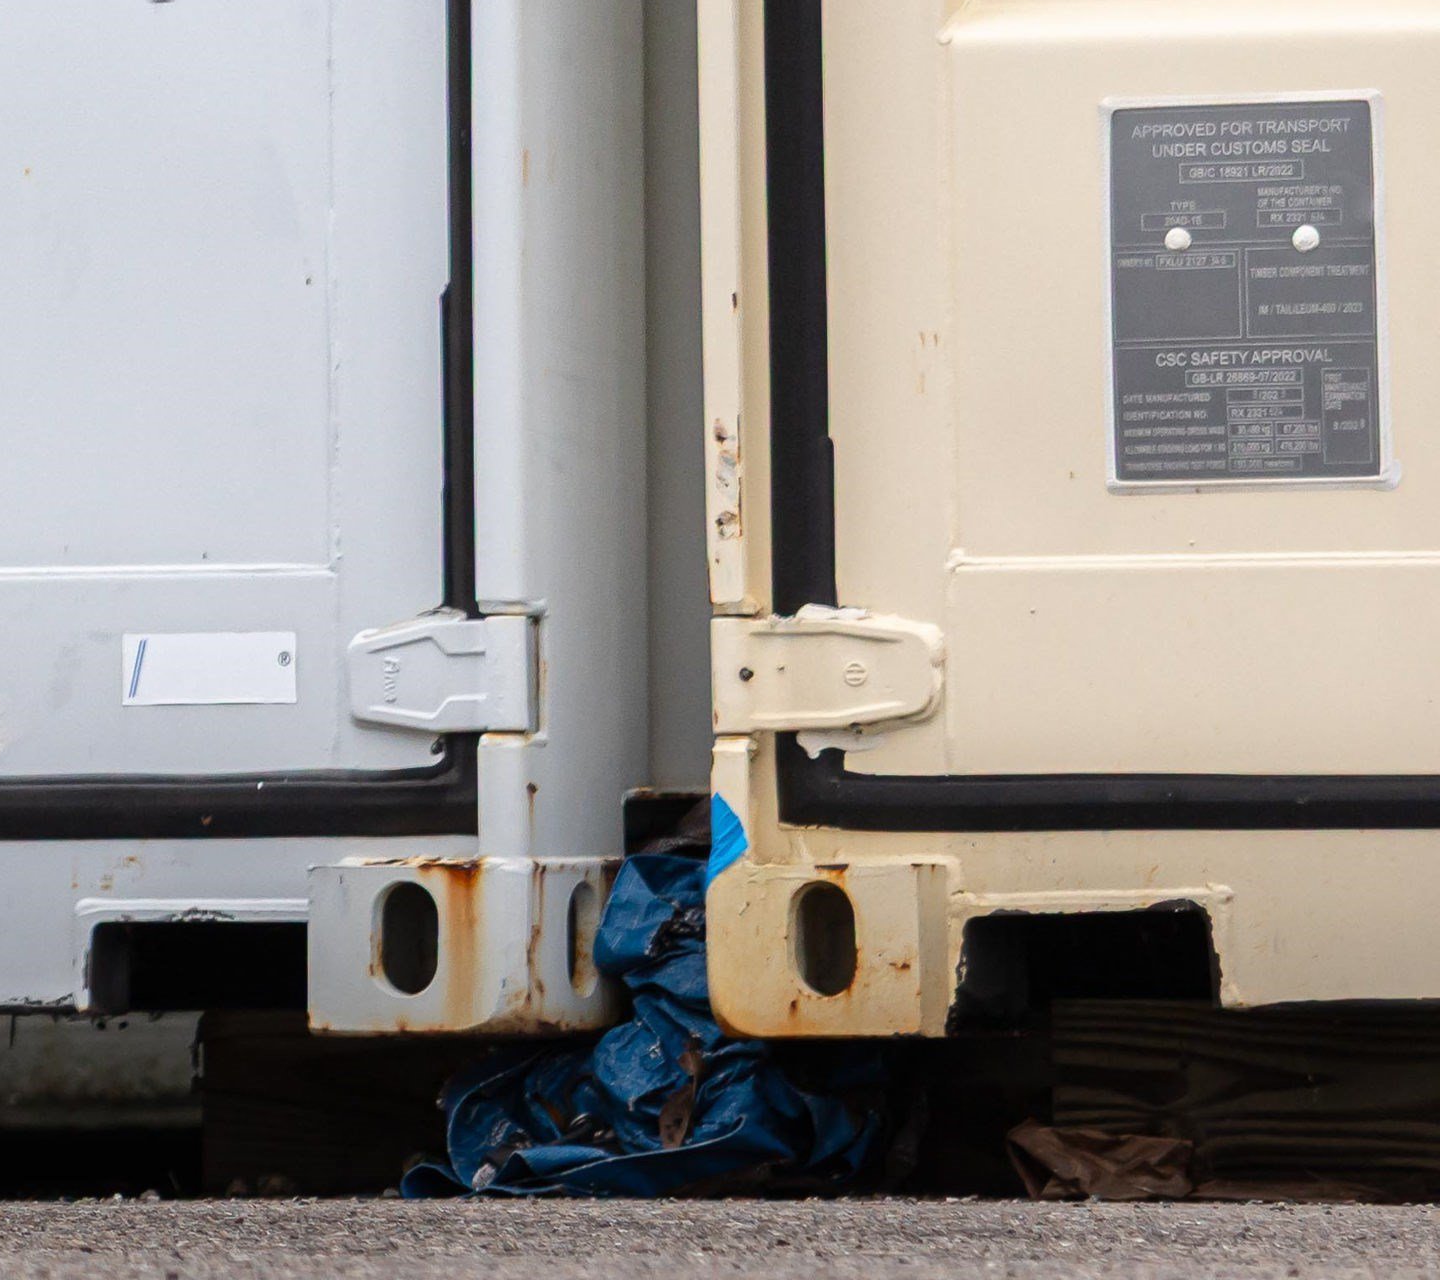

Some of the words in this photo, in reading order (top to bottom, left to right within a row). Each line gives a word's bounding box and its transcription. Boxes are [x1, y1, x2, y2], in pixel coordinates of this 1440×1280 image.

[1131, 121, 1215, 140] APPROVED
[1220, 119, 1252, 136] FOR
[1255, 118, 1351, 136] TRANSPORT
[1152, 142, 1206, 158] UNDER
[1210, 140, 1286, 156] CUSTOMS
[1291, 139, 1330, 153] SEAL
[1155, 352, 1187, 367] CSC
[1190, 351, 1249, 365] SAFETY
[1252, 348, 1333, 363] APPROVAL
